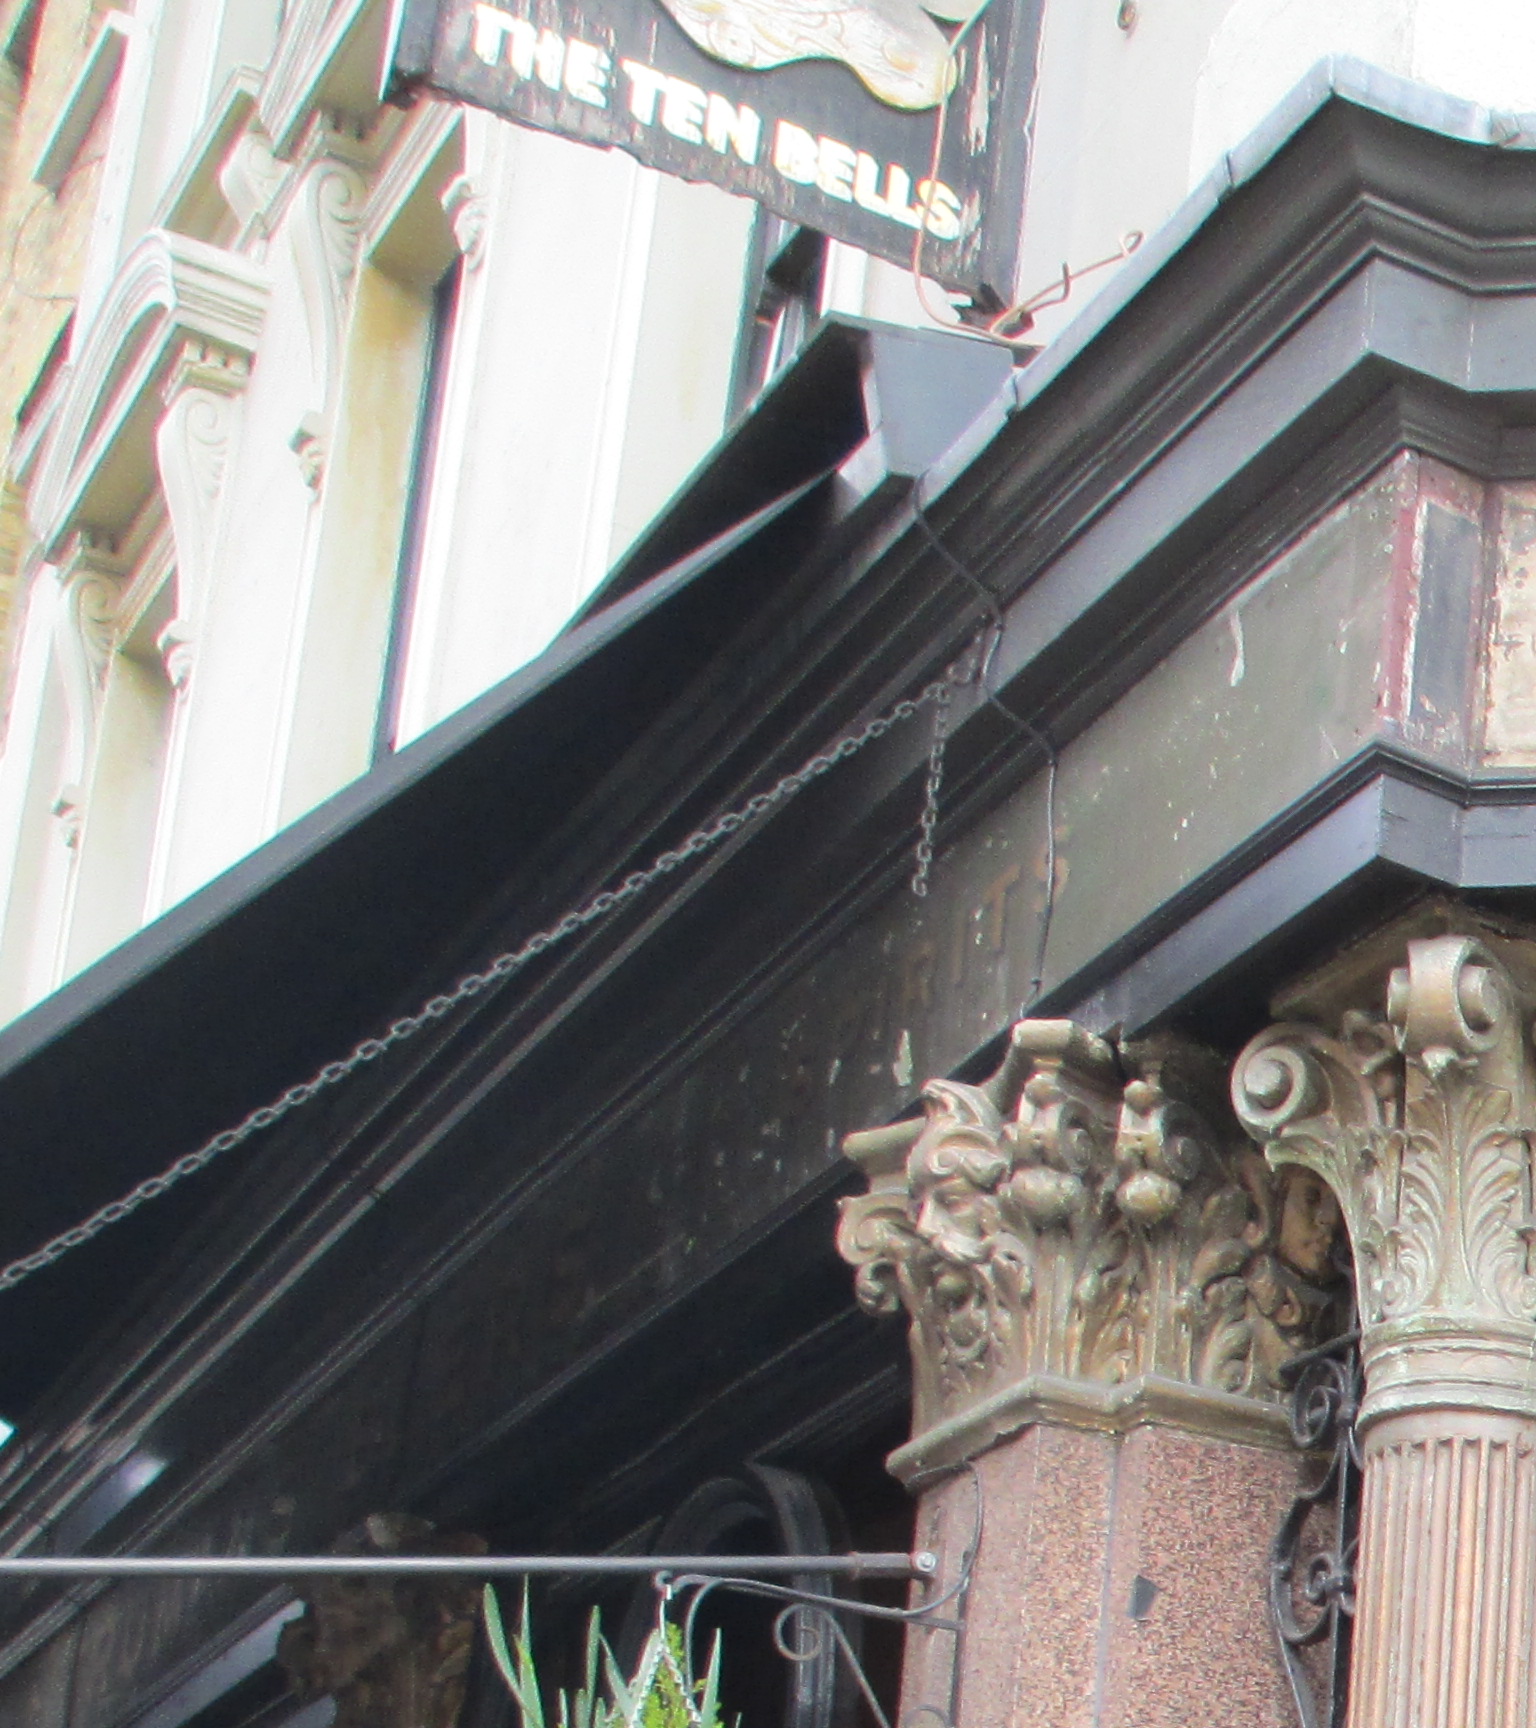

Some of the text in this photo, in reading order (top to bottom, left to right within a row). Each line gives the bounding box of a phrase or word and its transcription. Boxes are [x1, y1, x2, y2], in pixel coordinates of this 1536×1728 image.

[470, 4, 963, 241] THE TEN BELLS
